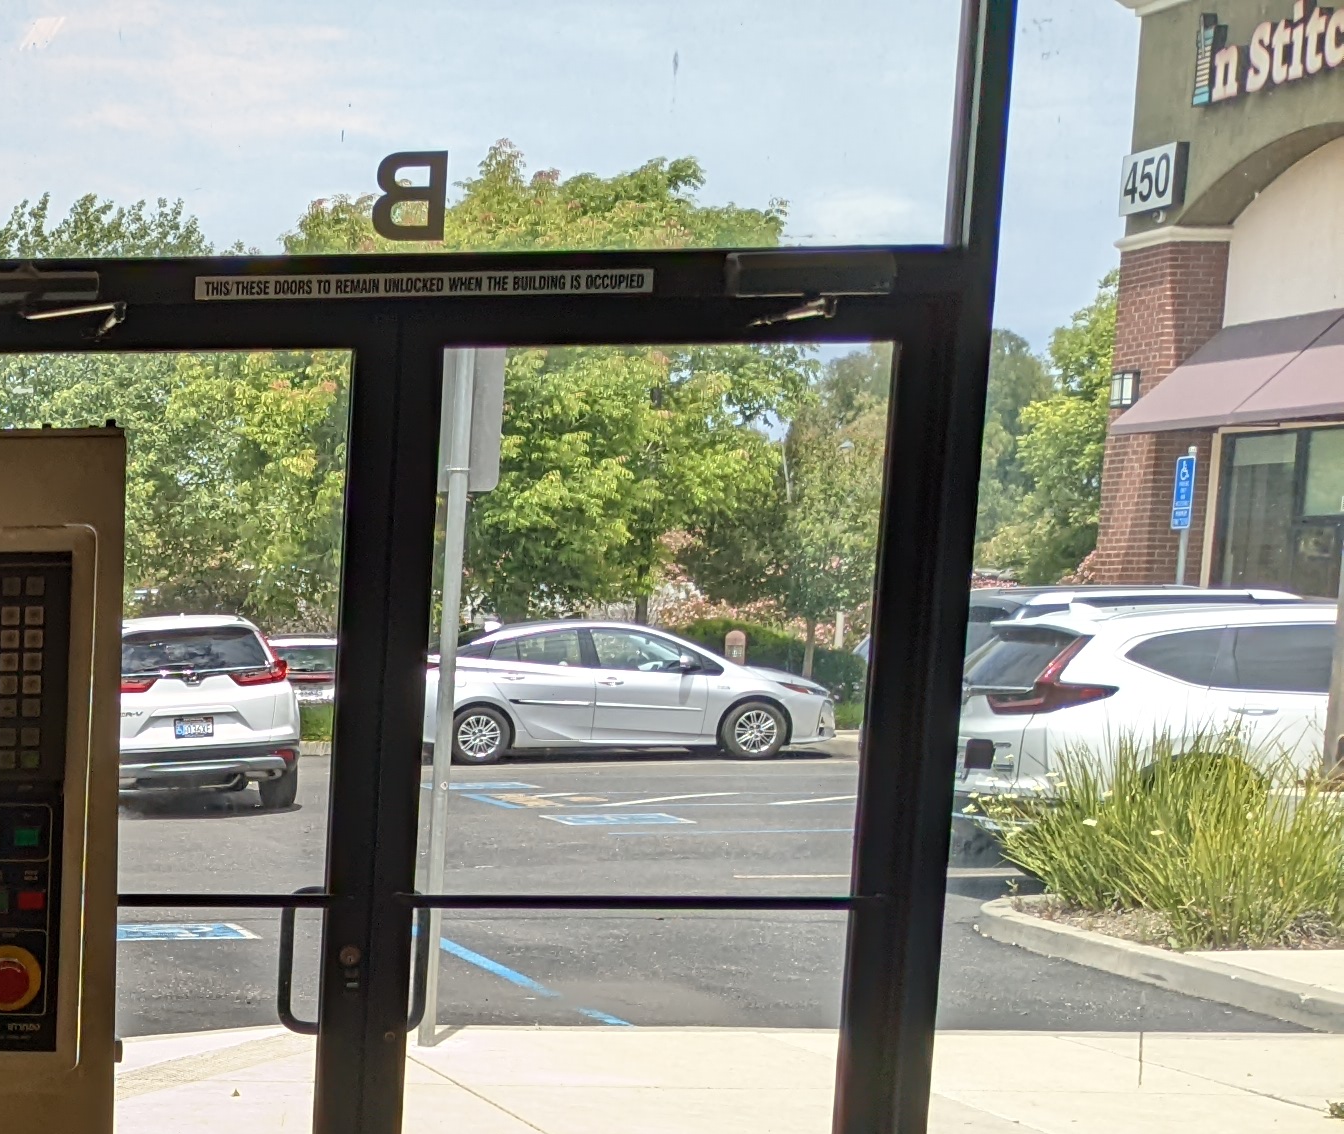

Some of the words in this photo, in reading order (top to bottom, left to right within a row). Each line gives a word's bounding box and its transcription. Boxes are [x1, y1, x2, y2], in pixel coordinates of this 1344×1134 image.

[1123, 152, 1170, 204] 450
[205, 280, 270, 296] THIS/THESE
[274, 279, 312, 295] DOORS
[317, 279, 331, 294] TO
[336, 278, 379, 294] REMAIN
[384, 277, 443, 293] UNLOCKED
[449, 276, 482, 292] WHEN
[487, 276, 508, 291] THE
[513, 275, 565, 291] BUILDING
[570, 274, 581, 290] IS
[586, 273, 644, 289] OCCUPIED
